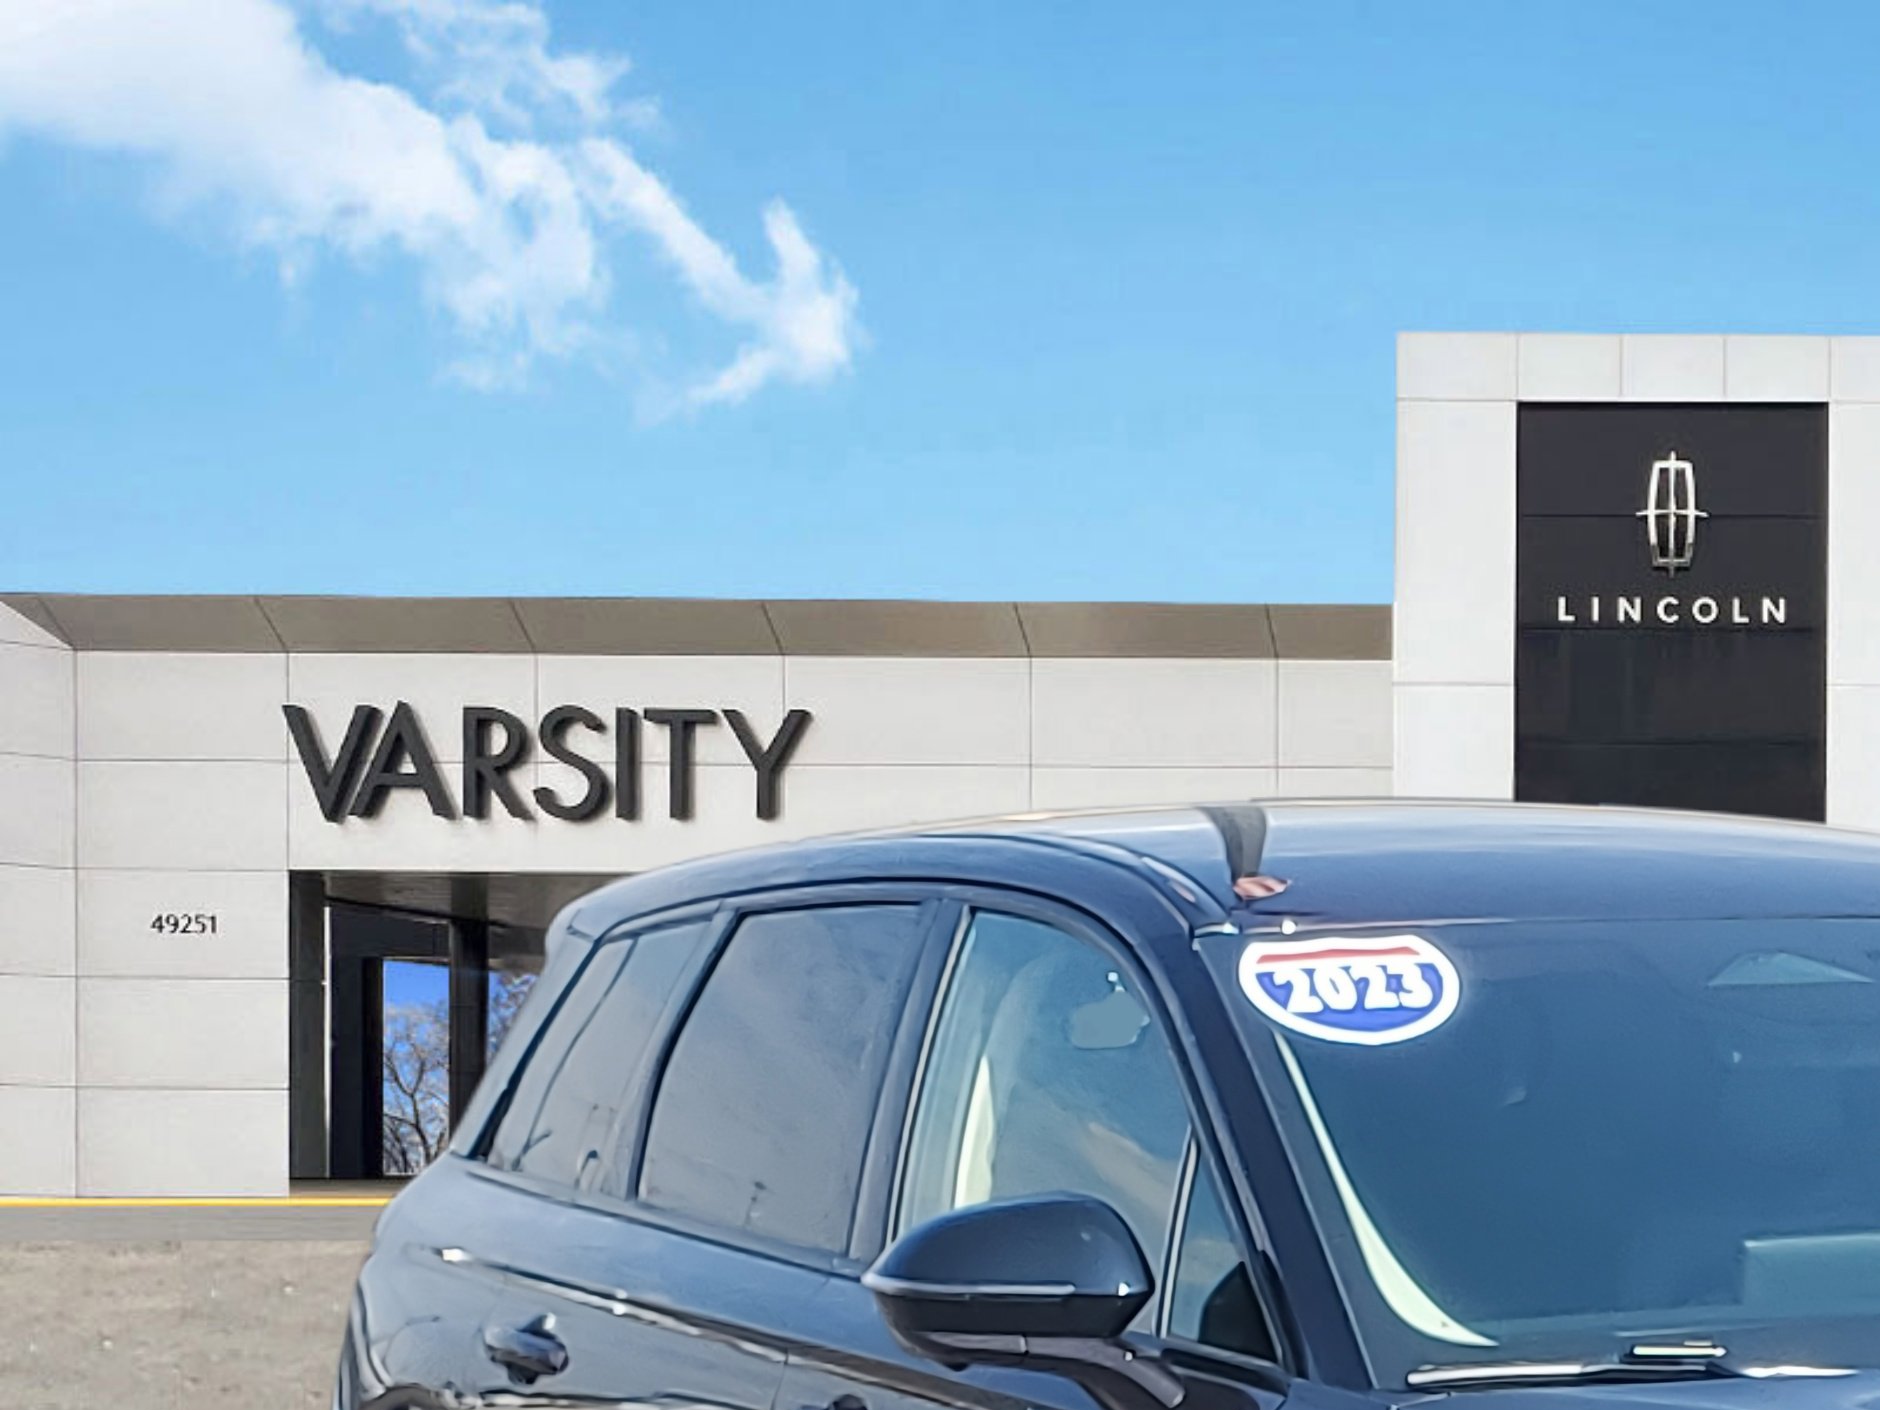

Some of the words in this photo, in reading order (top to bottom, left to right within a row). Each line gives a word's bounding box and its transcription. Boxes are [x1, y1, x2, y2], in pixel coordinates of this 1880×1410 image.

[1557, 595, 1787, 624] LINCOLN
[282, 700, 813, 823] VARSITY
[150, 913, 217, 934] 49251
[1272, 962, 1435, 1014] 2023
